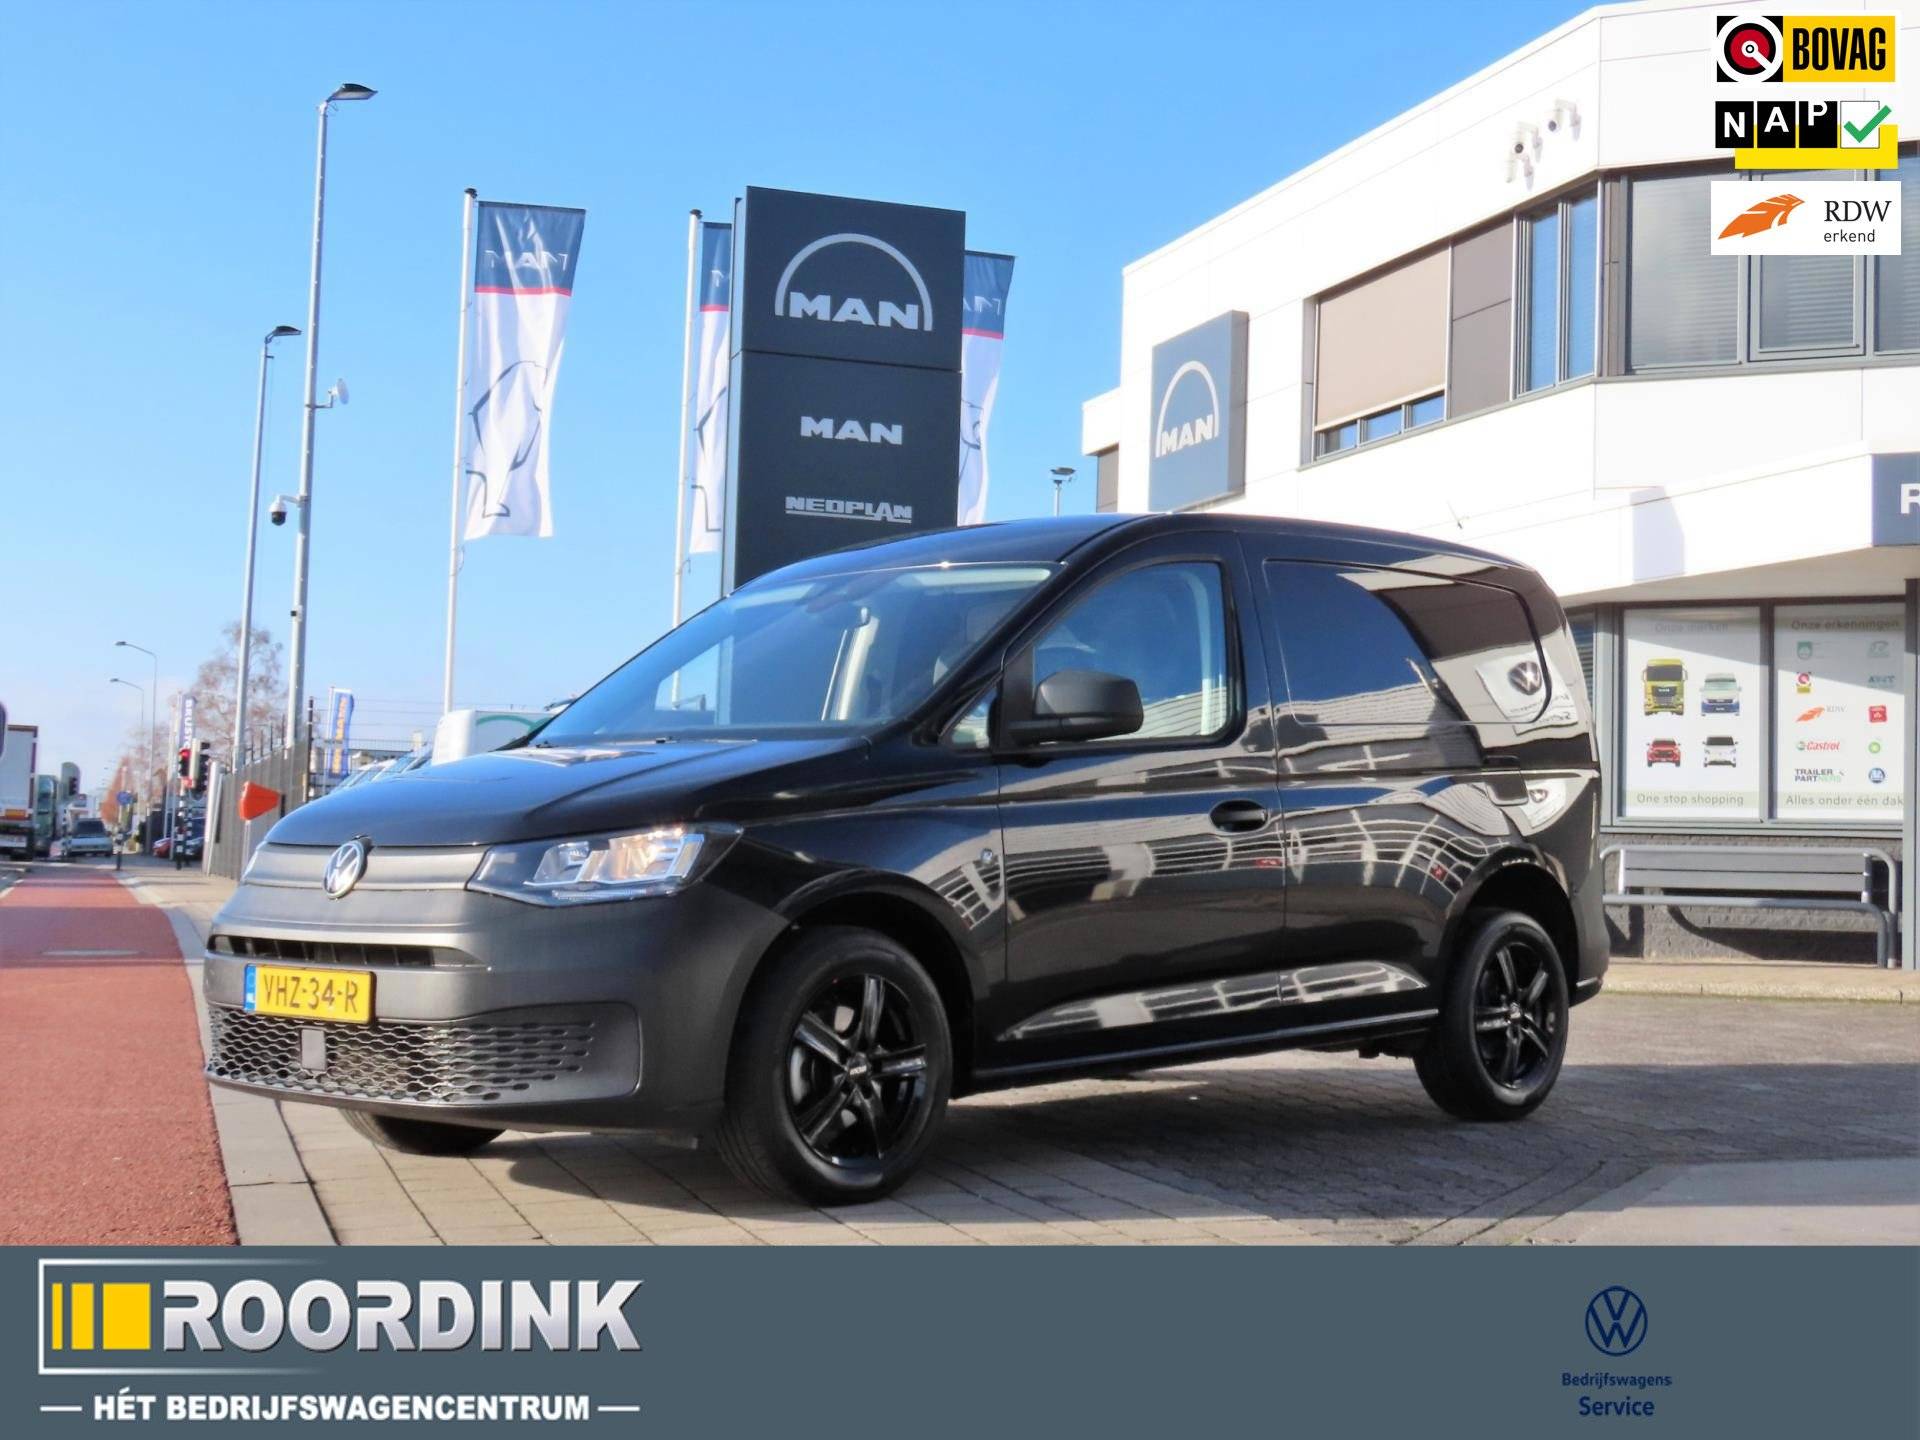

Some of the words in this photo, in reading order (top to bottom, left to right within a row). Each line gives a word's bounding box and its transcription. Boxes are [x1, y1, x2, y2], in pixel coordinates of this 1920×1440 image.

[790, 291, 919, 330] MAN
[801, 416, 903, 445] MAN
[1161, 414, 1214, 456] MAN
[785, 496, 912, 523] NEOPLAN
[1637, 793, 1659, 803] One
[1664, 793, 1687, 806] stop
[1691, 793, 1744, 807] shopping
[1786, 794, 1815, 805] Alles
[1818, 794, 1852, 805] onder
[1882, 795, 1904, 806] dak
[263, 974, 359, 1014] VHZ-34-R
